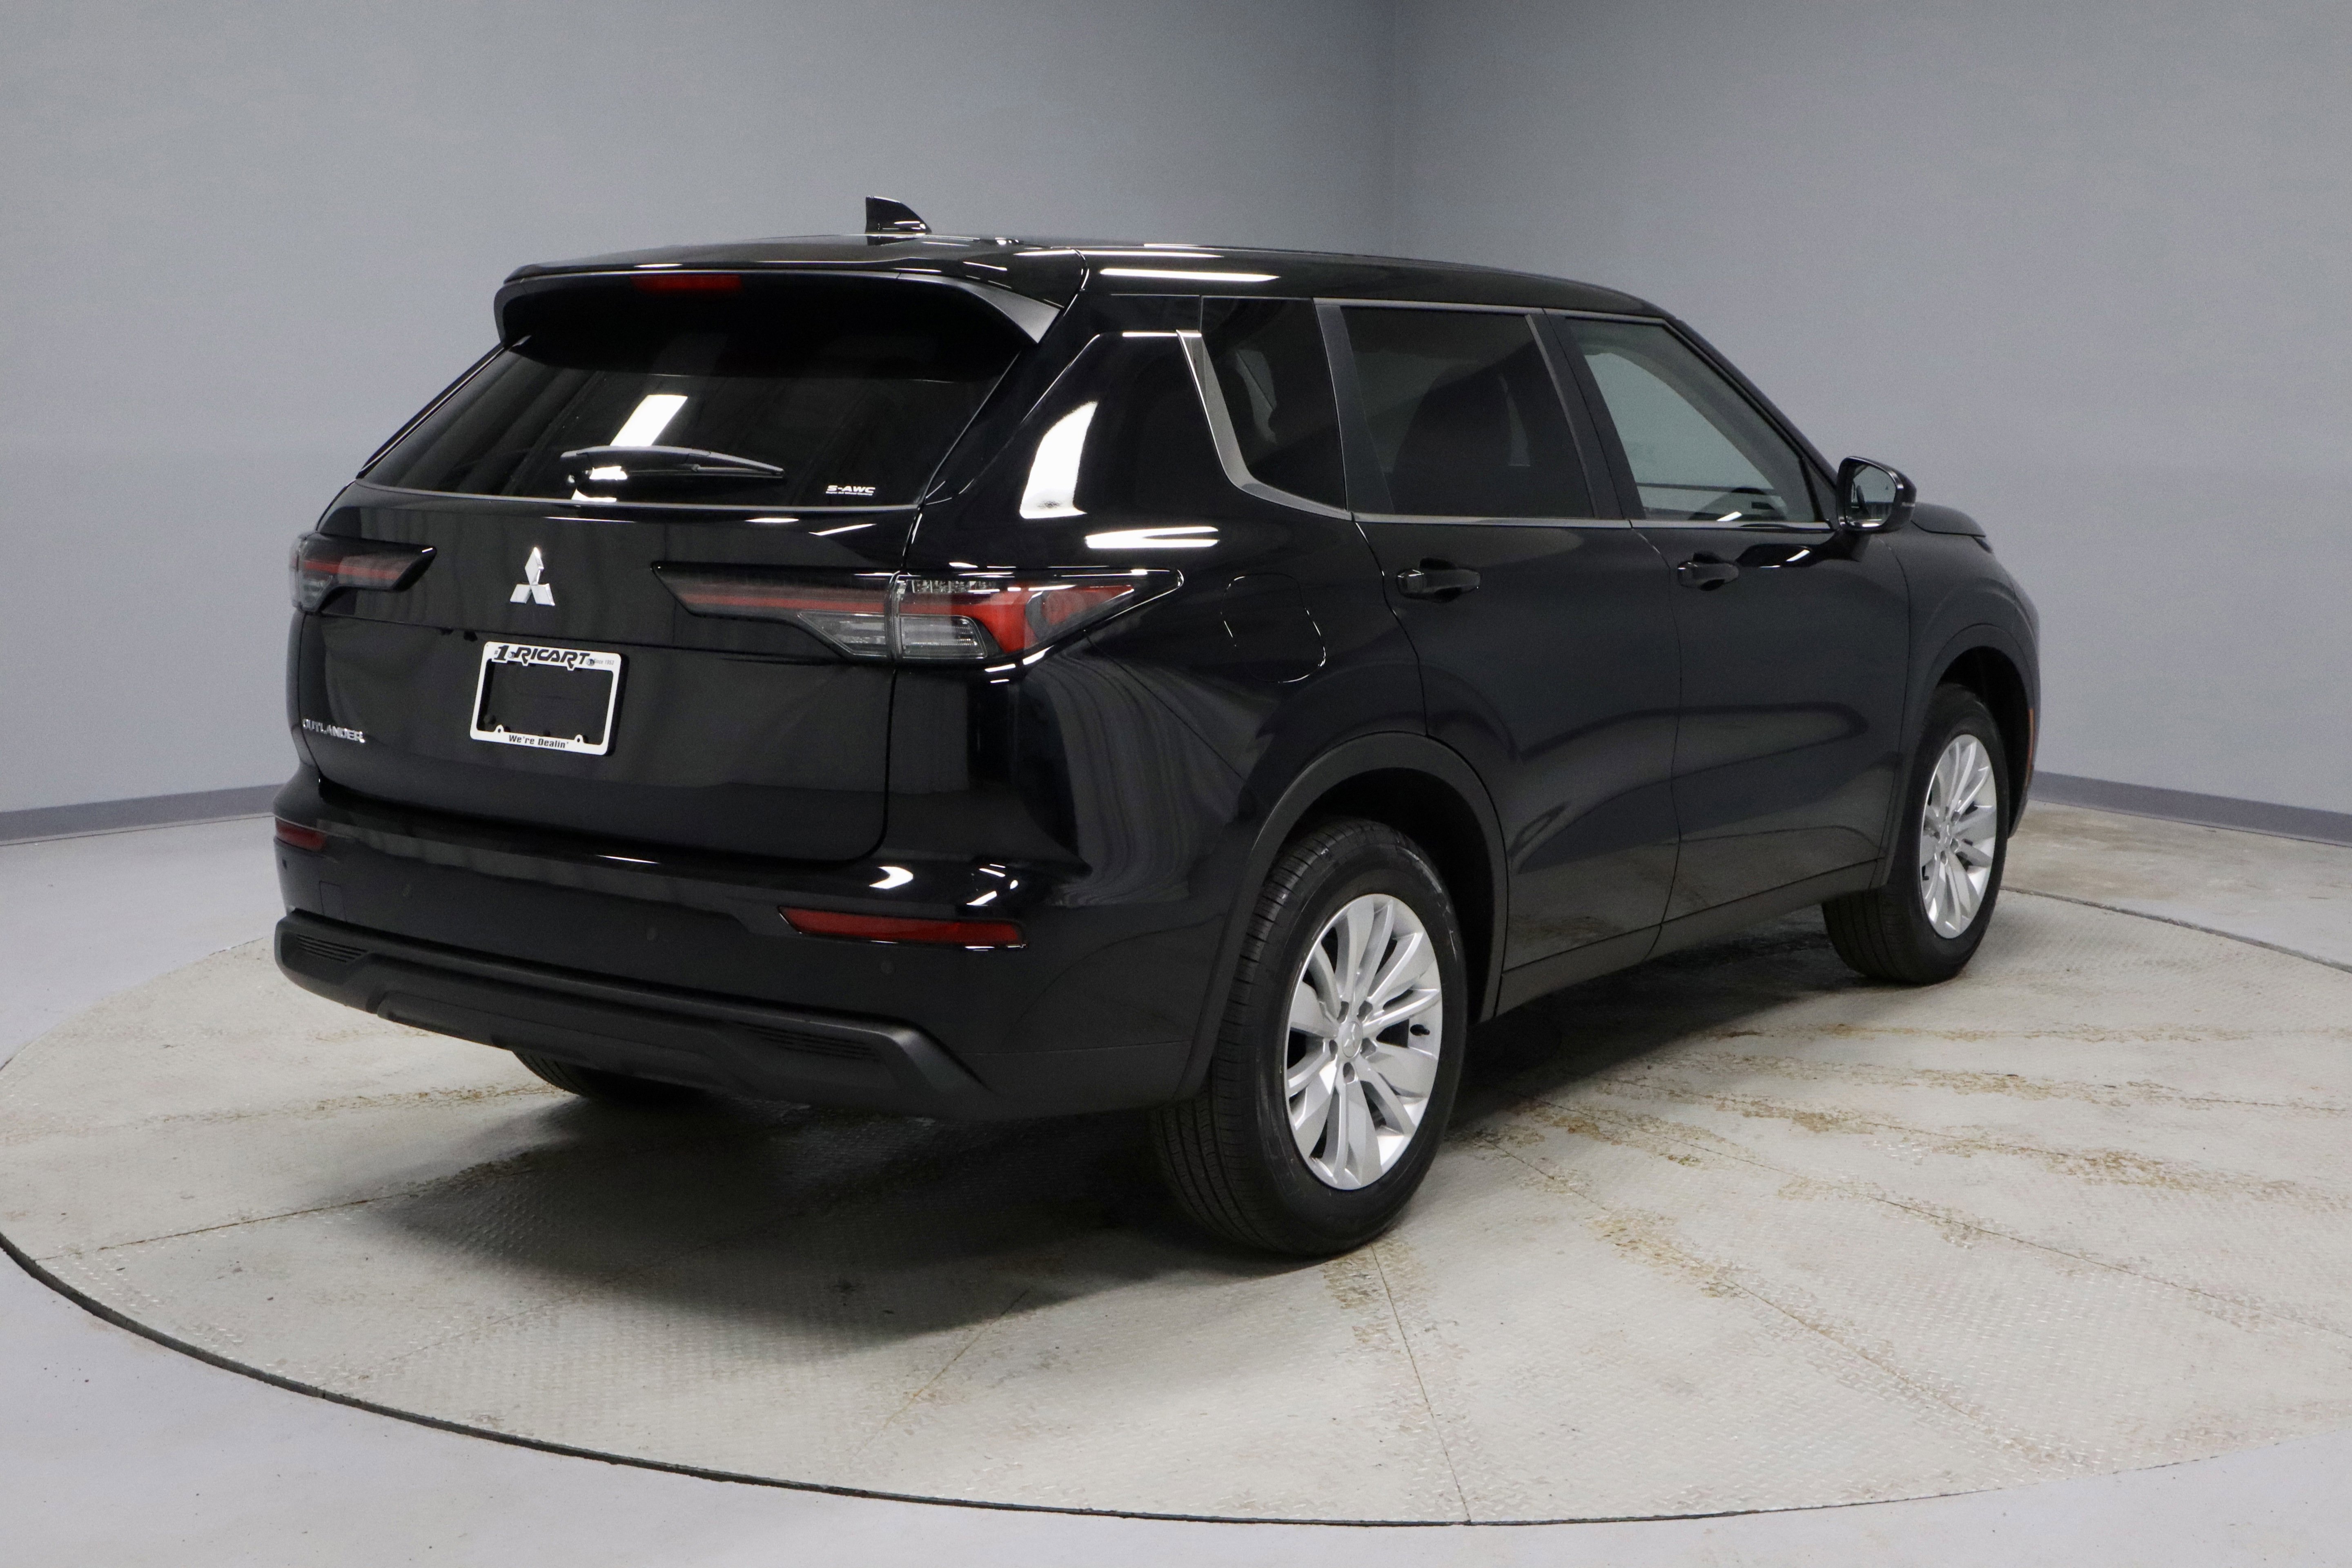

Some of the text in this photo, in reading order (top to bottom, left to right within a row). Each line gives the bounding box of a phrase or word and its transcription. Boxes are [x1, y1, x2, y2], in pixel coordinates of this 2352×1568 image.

[826, 485, 875, 493] S-AWC
[494, 645, 509, 661] #1
[512, 646, 590, 669] RICART
[302, 718, 365, 743] OUTLANDER
[509, 735, 569, 748] We're Dealin'
